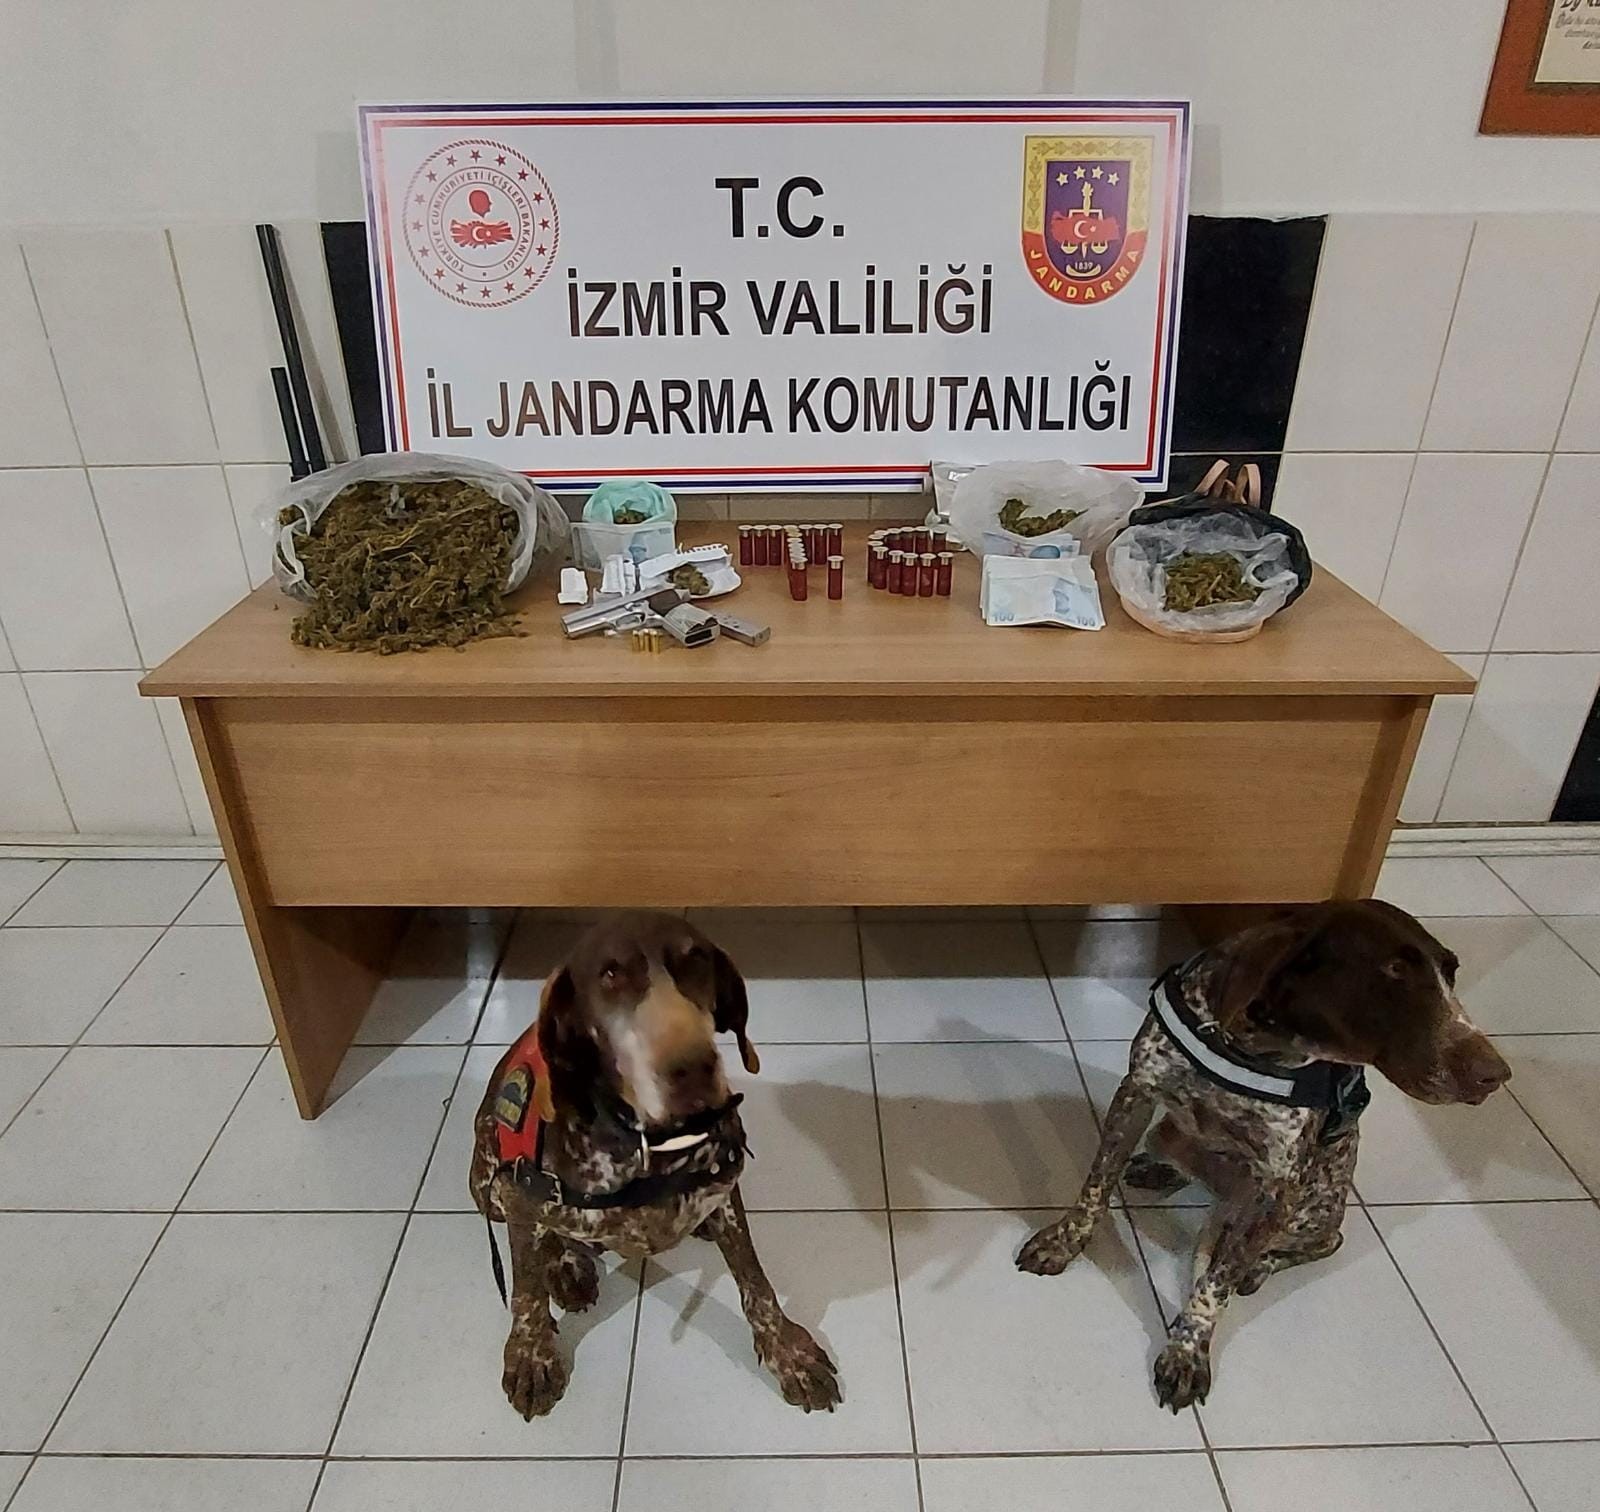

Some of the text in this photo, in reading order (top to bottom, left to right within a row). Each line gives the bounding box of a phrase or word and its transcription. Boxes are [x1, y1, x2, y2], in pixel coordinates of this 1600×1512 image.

[432, 171, 530, 272] TÜRKİYE CUMHURİYETİ İÇİŞLERİ BAKANLIĞI
[715, 177, 845, 238] T.C.
[568, 263, 992, 337] İZMİR VALİLİĞİ
[1031, 250, 1139, 299] JANDARMA
[427, 360, 1131, 438] İL JANDARMA KOMUTANLIĞI
